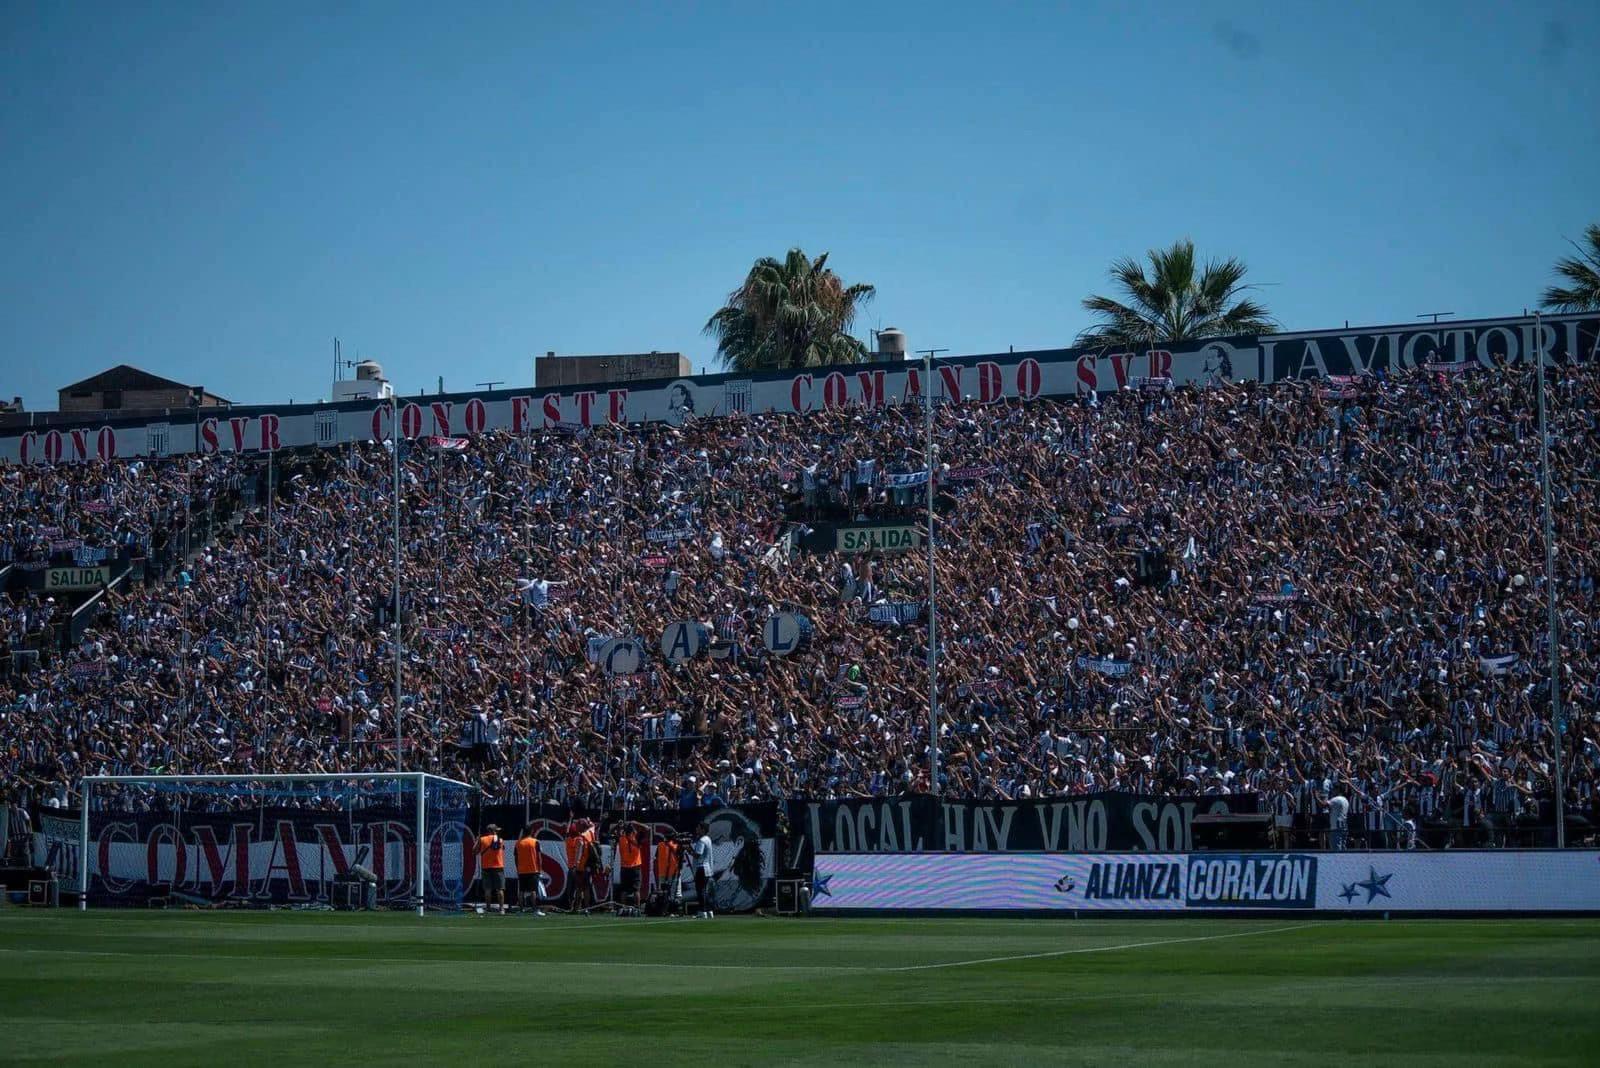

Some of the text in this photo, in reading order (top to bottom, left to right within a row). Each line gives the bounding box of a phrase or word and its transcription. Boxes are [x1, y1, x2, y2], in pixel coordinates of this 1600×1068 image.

[1258, 321, 1600, 385] LA VICTORI
[791, 357, 1041, 413] COMANDO
[19, 413, 282, 468] CONO SVR
[371, 388, 629, 443] CONO ESTE
[844, 526, 916, 551] SALIDA
[51, 569, 104, 586] SALIDA
[772, 616, 794, 650] L
[808, 800, 923, 851] LOCAL
[943, 803, 1019, 851] HAY
[1131, 801, 1231, 851] SOL
[97, 819, 478, 900] COMANDO
[1085, 855, 1310, 901] ALIANZA CORAZÓN
